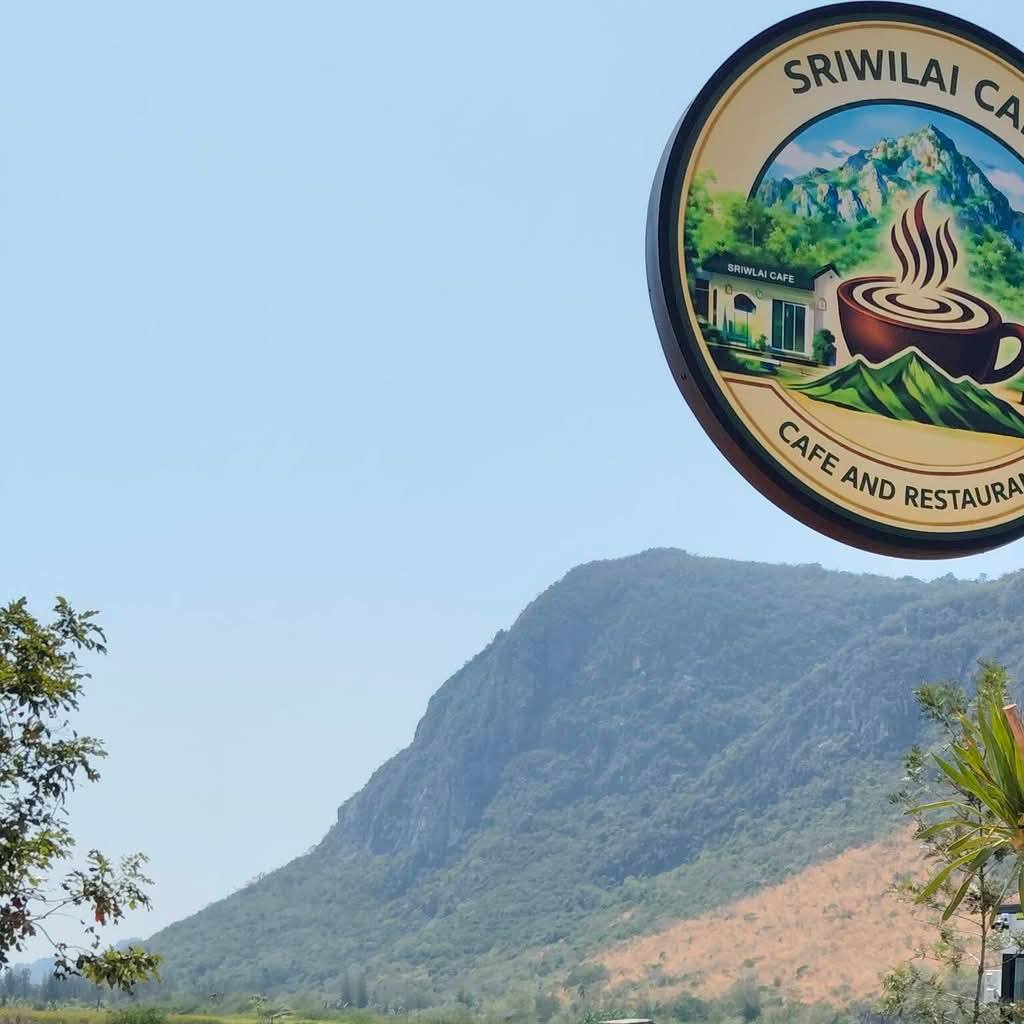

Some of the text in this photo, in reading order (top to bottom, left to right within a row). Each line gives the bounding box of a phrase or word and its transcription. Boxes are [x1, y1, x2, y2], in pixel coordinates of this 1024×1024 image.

[783, 49, 960, 95] SRIWILAI
[727, 263, 796, 284] SRIWLAI CAFE
[778, 421, 840, 476] CAFE
[841, 465, 896, 500] AND
